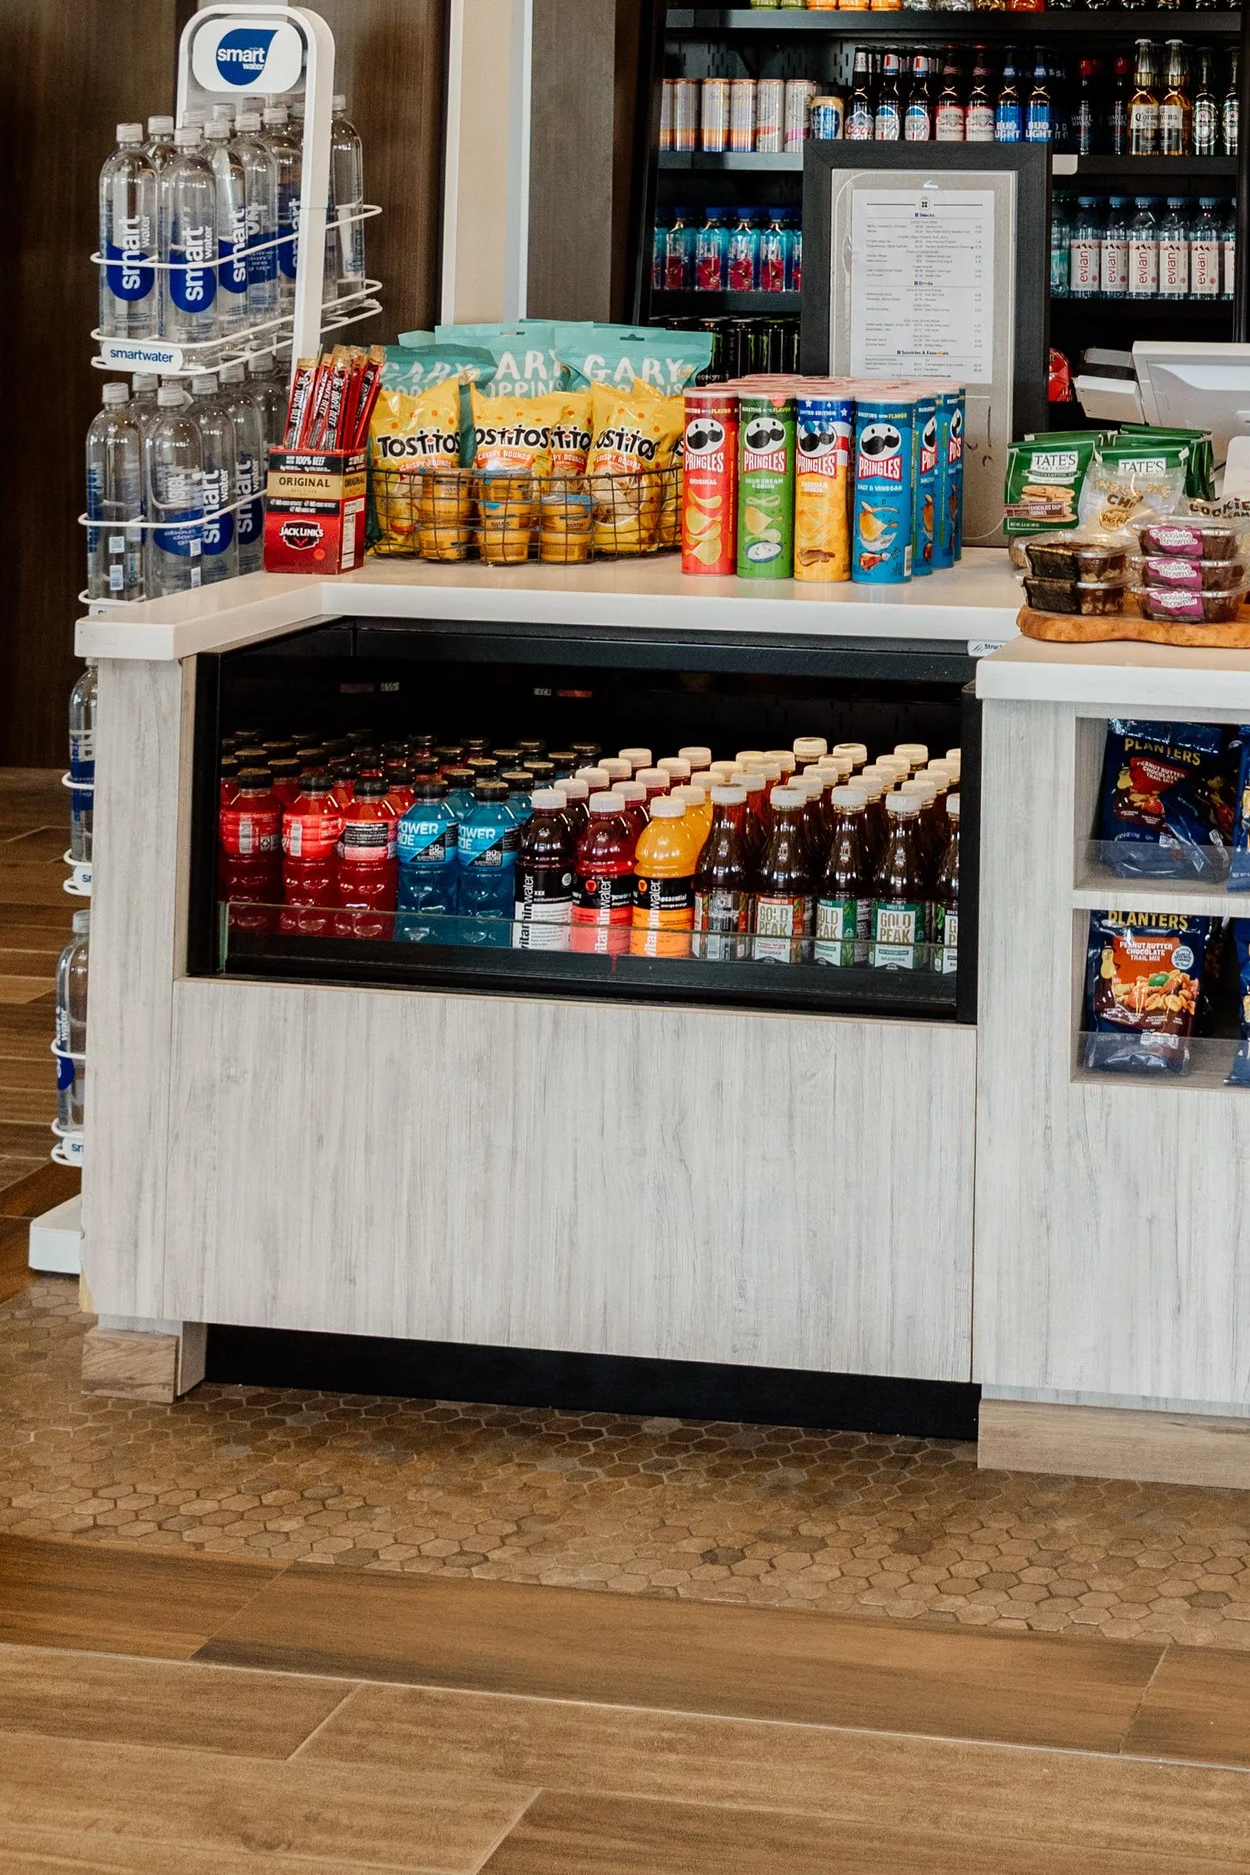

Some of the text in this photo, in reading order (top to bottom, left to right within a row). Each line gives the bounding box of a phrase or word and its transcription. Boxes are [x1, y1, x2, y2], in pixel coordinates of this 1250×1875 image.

[217, 47, 265, 63] smart
[995, 129, 1020, 138] LIGHT
[1026, 129, 1052, 138] LIGHT
[141, 215, 151, 249] water
[204, 225, 213, 259] water
[121, 215, 141, 290] smart
[232, 208, 246, 283] smart
[185, 226, 204, 302] smart
[1080, 250, 1089, 283] evian
[1108, 251, 1116, 283] evian
[1139, 252, 1148, 283] evian
[1167, 252, 1176, 284] evian
[1198, 252, 1206, 285] evian
[110, 347, 174, 364] smartwater
[583, 354, 684, 385] GARY
[475, 424, 551, 449] OSTITOS
[313, 456, 326, 465] BEEF
[477, 451, 531, 461] CRISPY ROUNDS
[685, 452, 724, 473] PRINGLES
[744, 451, 785, 474] PRINGLES
[798, 453, 835, 475] PRINGLES
[1034, 454, 1076, 466] TATE'S
[1121, 461, 1164, 473] TATE'S
[252, 459, 260, 493] water
[858, 456, 900, 481] PRINGLES
[220, 469, 229, 503] water
[279, 477, 331, 487] ORIGINAL
[202, 469, 220, 544] smart
[237, 459, 253, 534] smart
[281, 527, 300, 537] JACK
[1124, 737, 1201, 767] PLANTERS
[661, 894, 687, 902] essential
[519, 873, 534, 949] vitaminwater
[759, 905, 788, 922] GOLD
[880, 912, 911, 928] GOLD
[1107, 911, 1189, 930] PLANTERS
[759, 922, 787, 936] PEAK
[880, 928, 911, 943] PEAK
[1119, 941, 1173, 950] PEANUT BUTTER
[1126, 948, 1165, 956] CHOCOLATE
[1149, 954, 1161, 962] MIX
